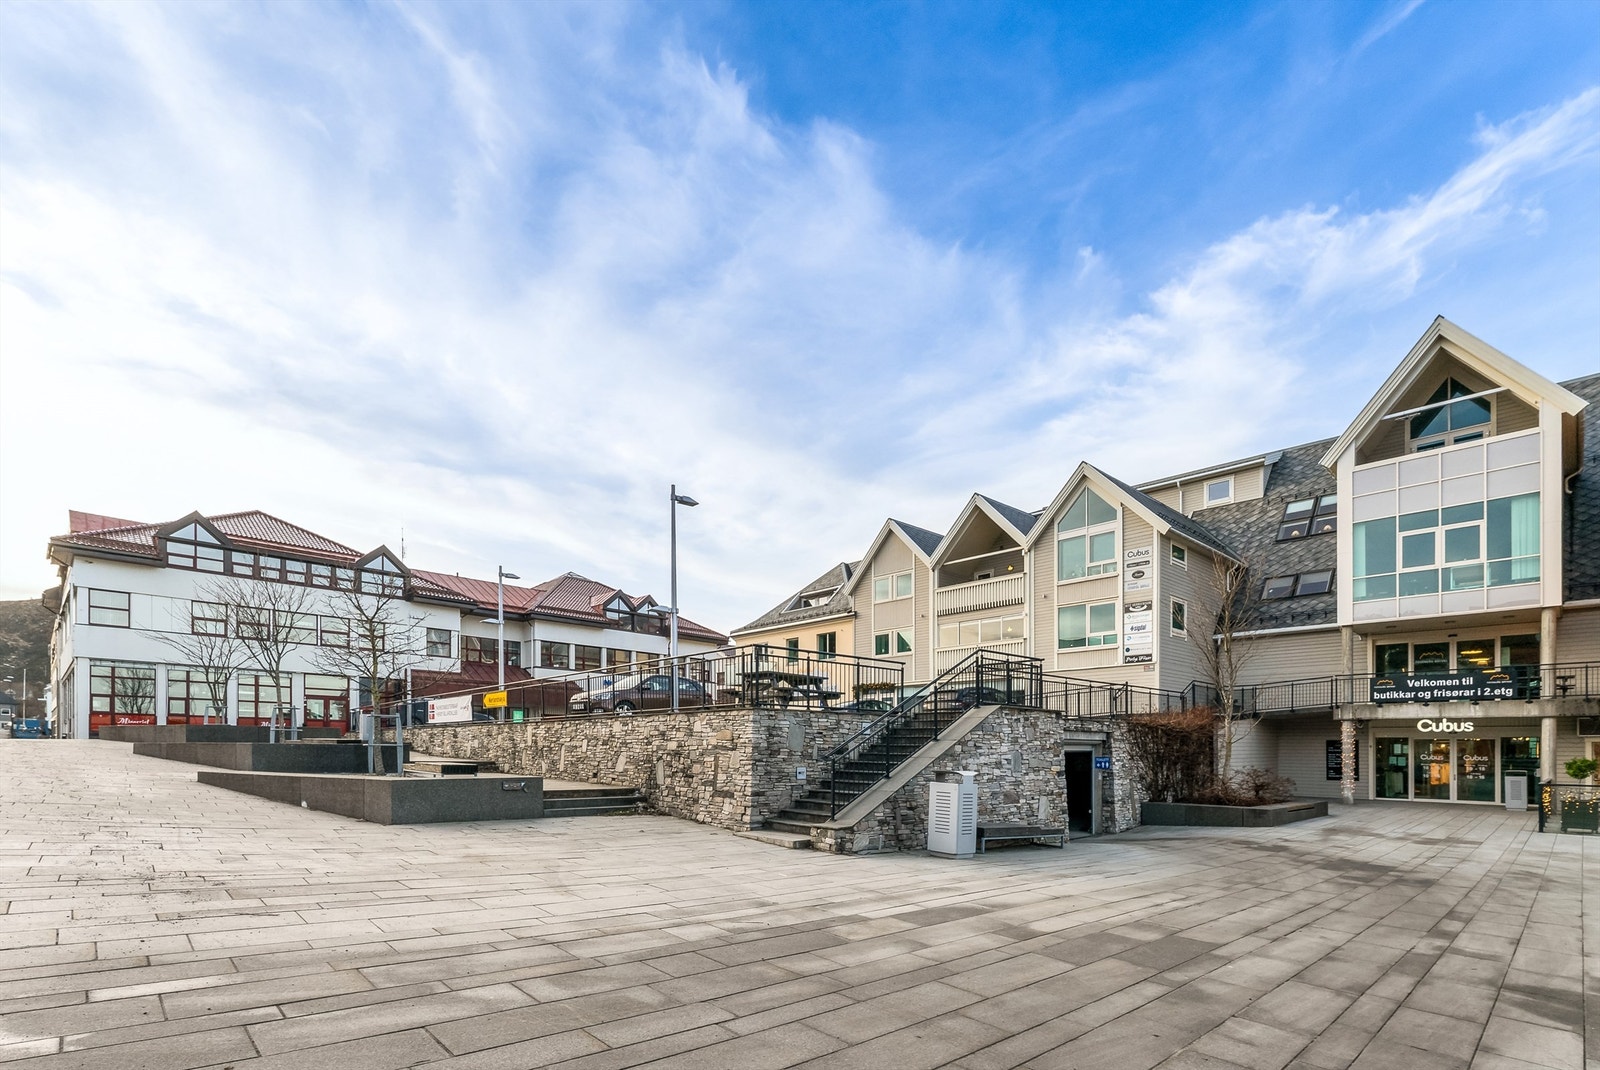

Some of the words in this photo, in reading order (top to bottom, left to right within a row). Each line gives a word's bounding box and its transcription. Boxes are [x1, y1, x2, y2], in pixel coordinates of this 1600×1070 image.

[1127, 549, 1150, 558] Cubus
[1407, 679, 1459, 688] Velkomen
[1461, 677, 1474, 686] til
[1373, 691, 1415, 700] butikkar
[1417, 691, 1431, 699] og
[1433, 688, 1475, 697] frisørar
[1483, 687, 1513, 697] 2.etg
[1417, 718, 1474, 733] Cubus
[1420, 753, 1444, 761] Cubus
[1463, 754, 1489, 762] Cubus
